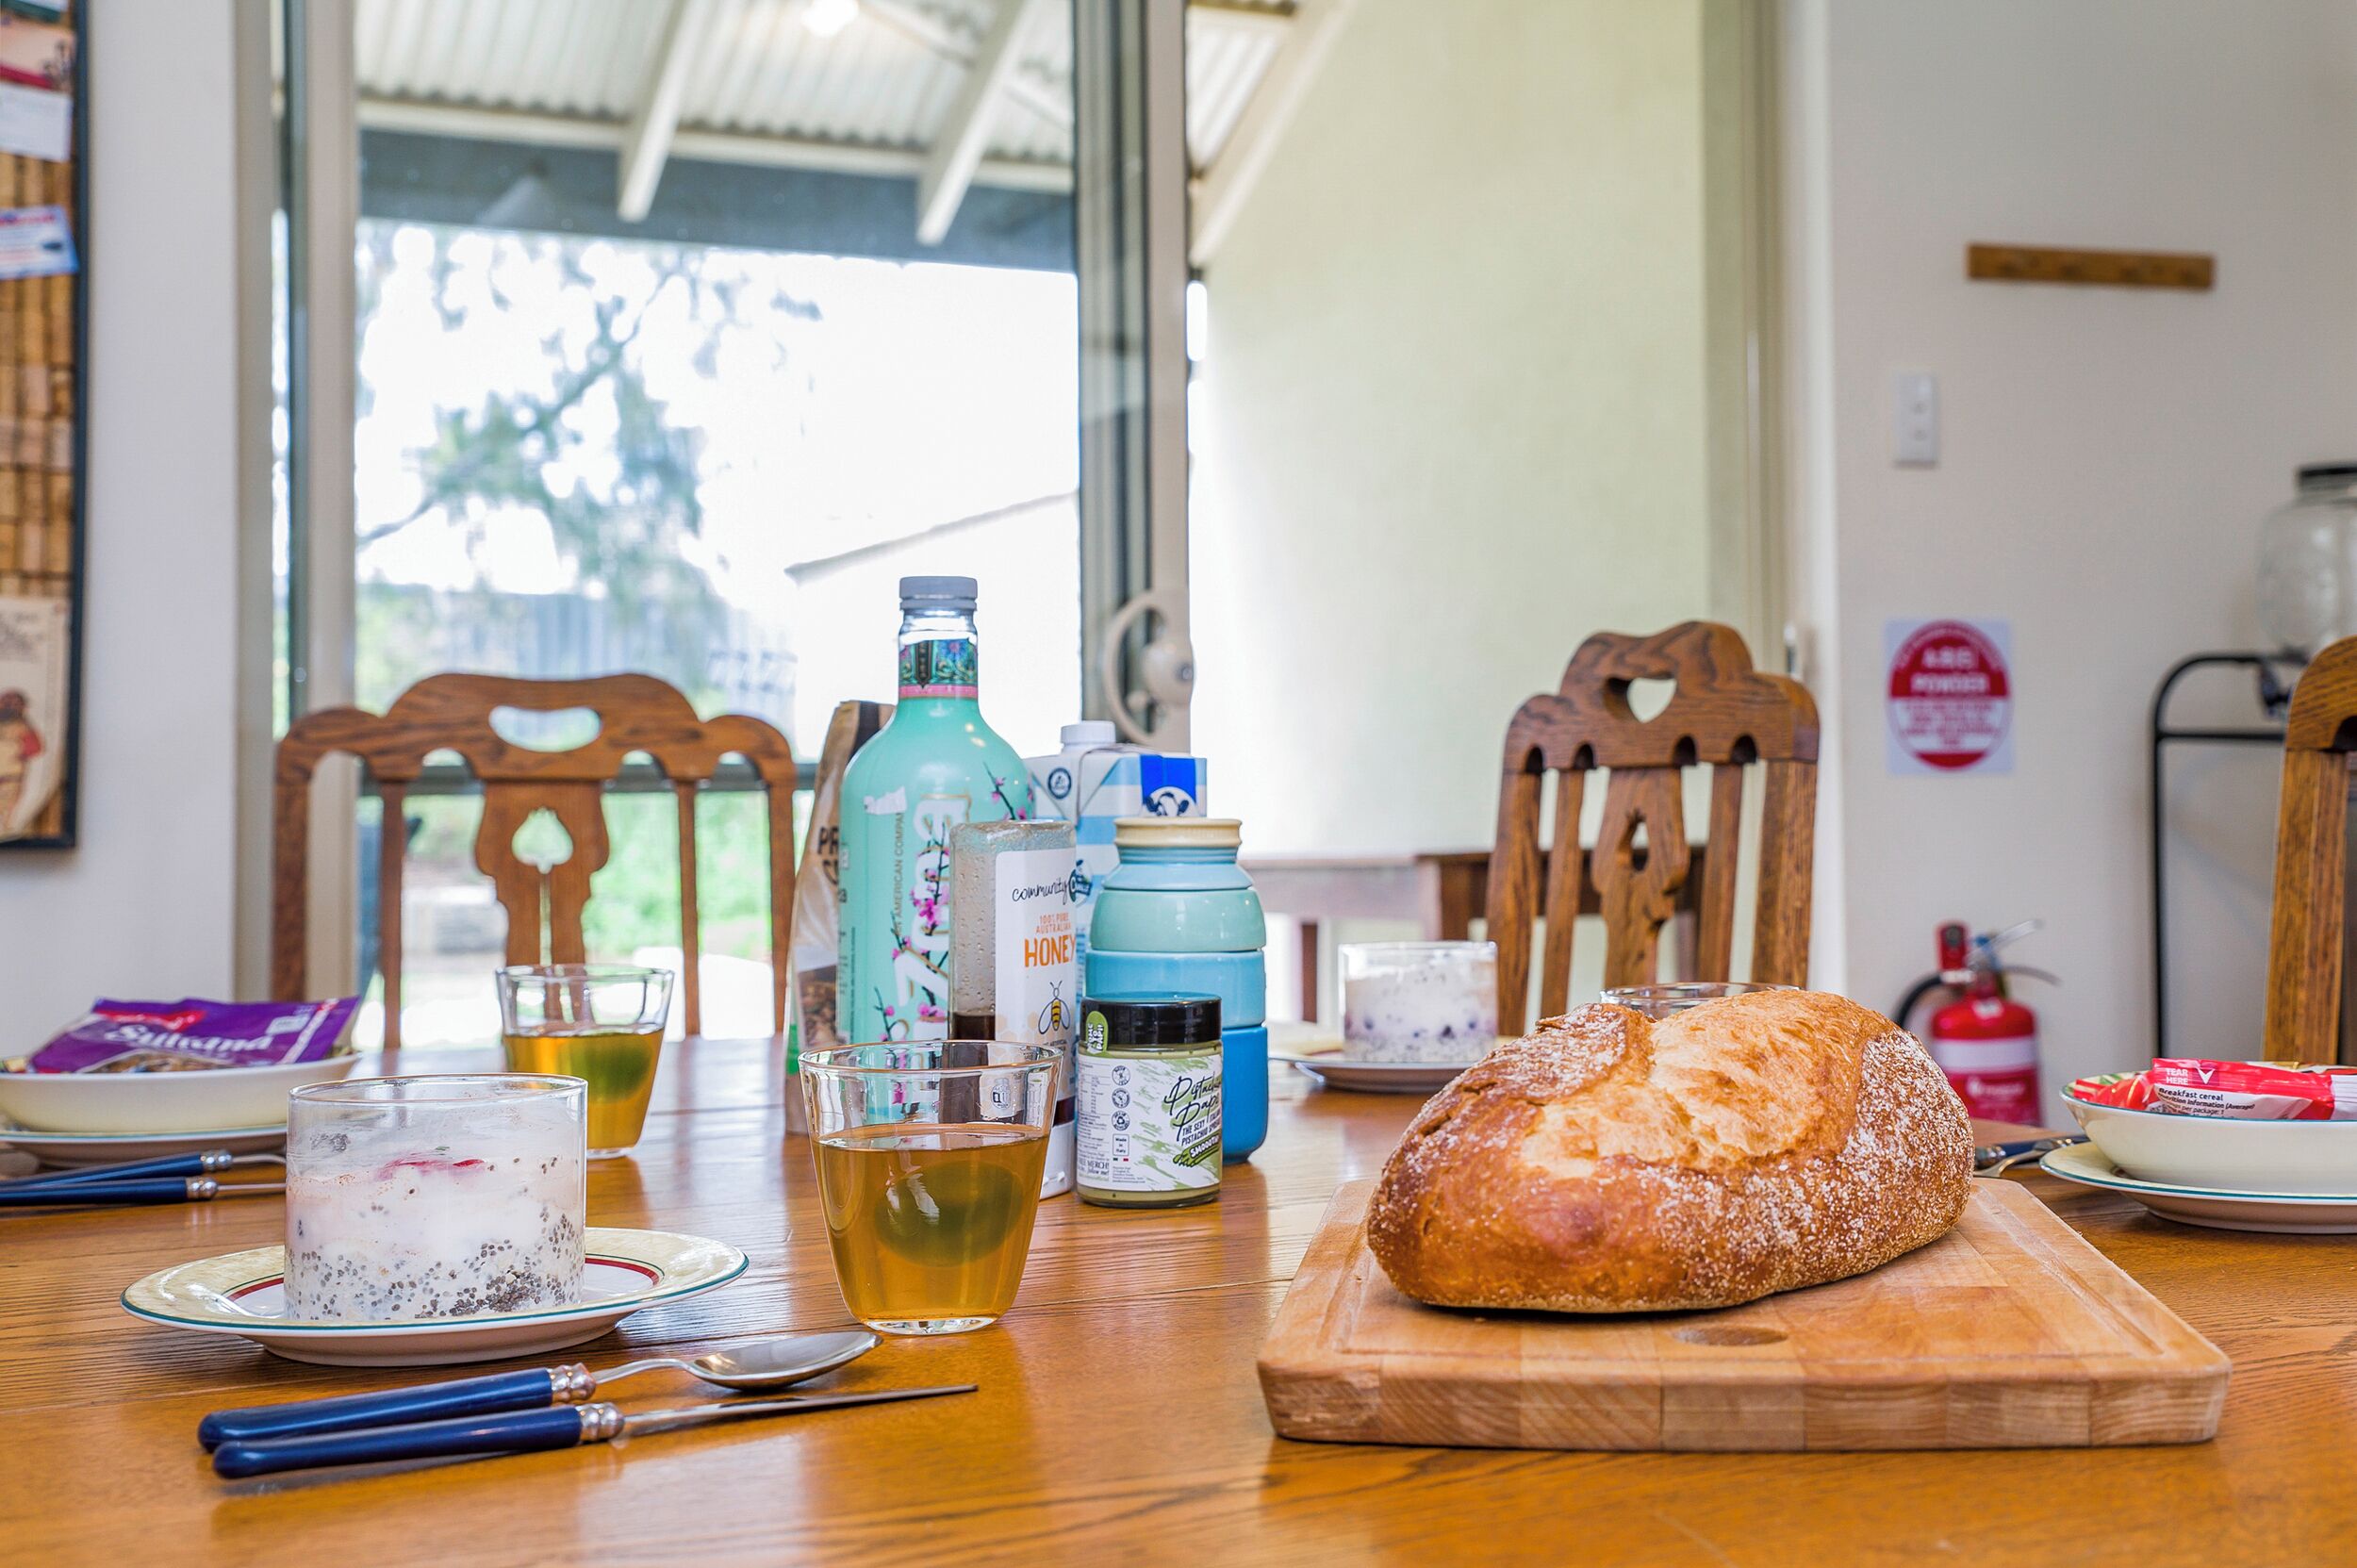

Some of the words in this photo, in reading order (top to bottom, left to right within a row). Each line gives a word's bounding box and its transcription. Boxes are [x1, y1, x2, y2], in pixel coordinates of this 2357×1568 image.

[895, 812, 904, 857] COMPA
[894, 859, 903, 917] AMERICAN
[1012, 878, 1068, 905] community
[1024, 933, 1076, 967] HONEY
[2166, 1067, 2189, 1077] TEAR
[2166, 1076, 2189, 1085] HERE
[2158, 1087, 2198, 1099] Breakfast
[2187, 1098, 2225, 1108] Information
[1172, 1092, 1220, 1142] Papi
[2193, 1107, 2219, 1115] package:
[1182, 1125, 1193, 1136] THE
